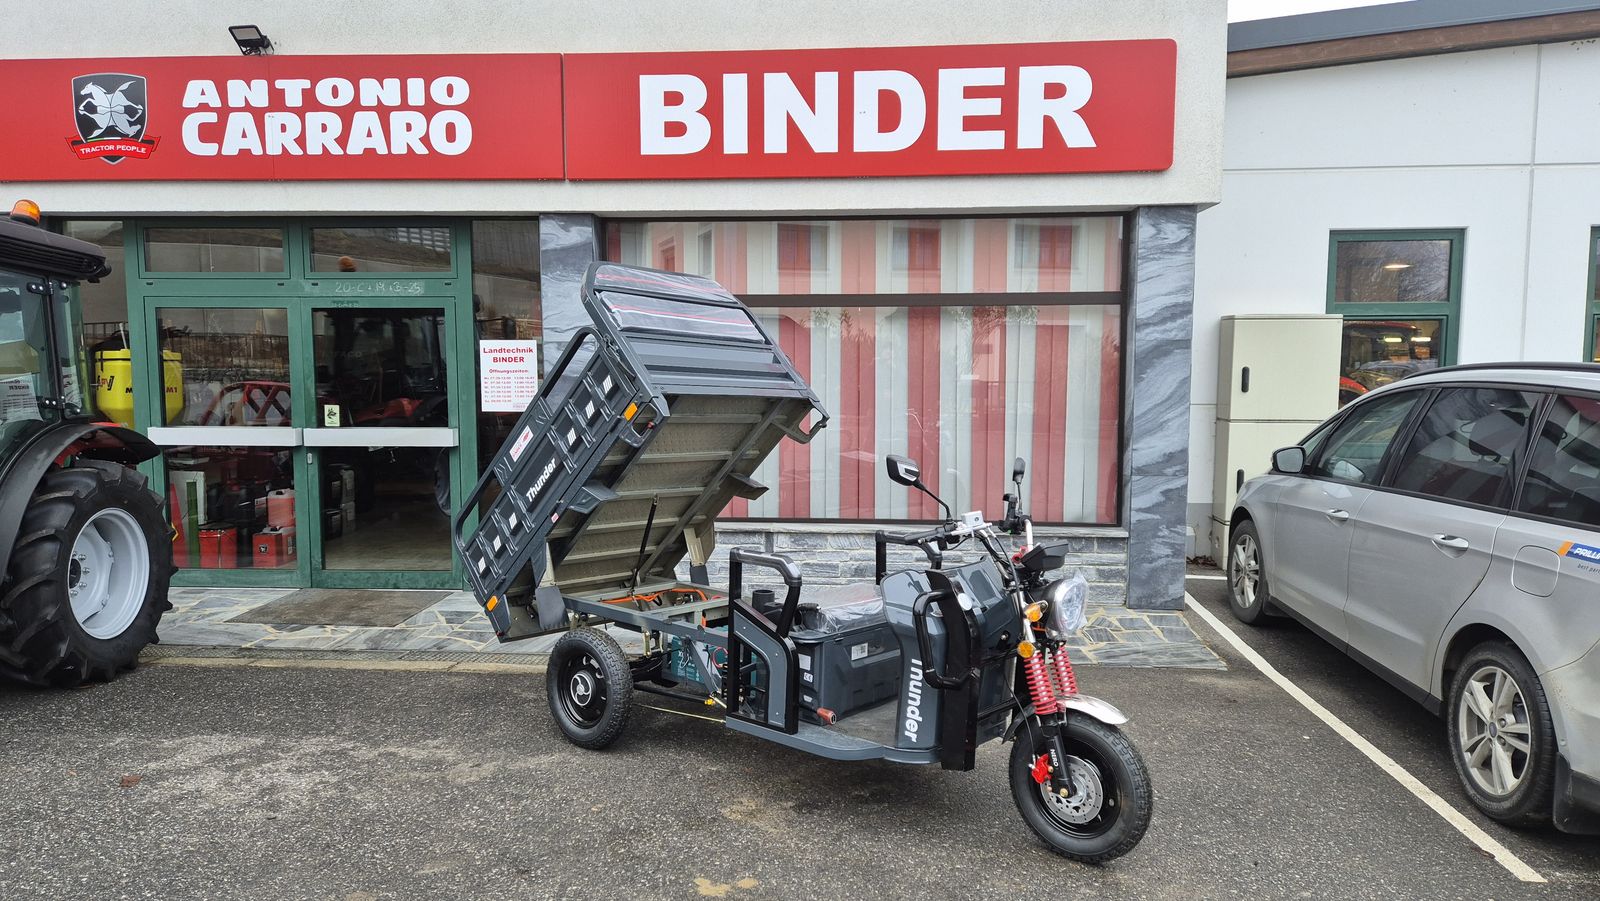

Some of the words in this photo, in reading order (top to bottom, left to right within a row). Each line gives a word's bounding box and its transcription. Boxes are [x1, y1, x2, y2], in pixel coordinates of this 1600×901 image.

[182, 76, 470, 108] ANTONIO
[639, 65, 1096, 156] BINDER
[80, 144, 115, 155] TRACTOR
[116, 144, 147, 154] PEOPLE
[182, 110, 472, 156] CARRARO
[525, 457, 557, 502] Thunder
[1050, 748, 1059, 767] NERO
